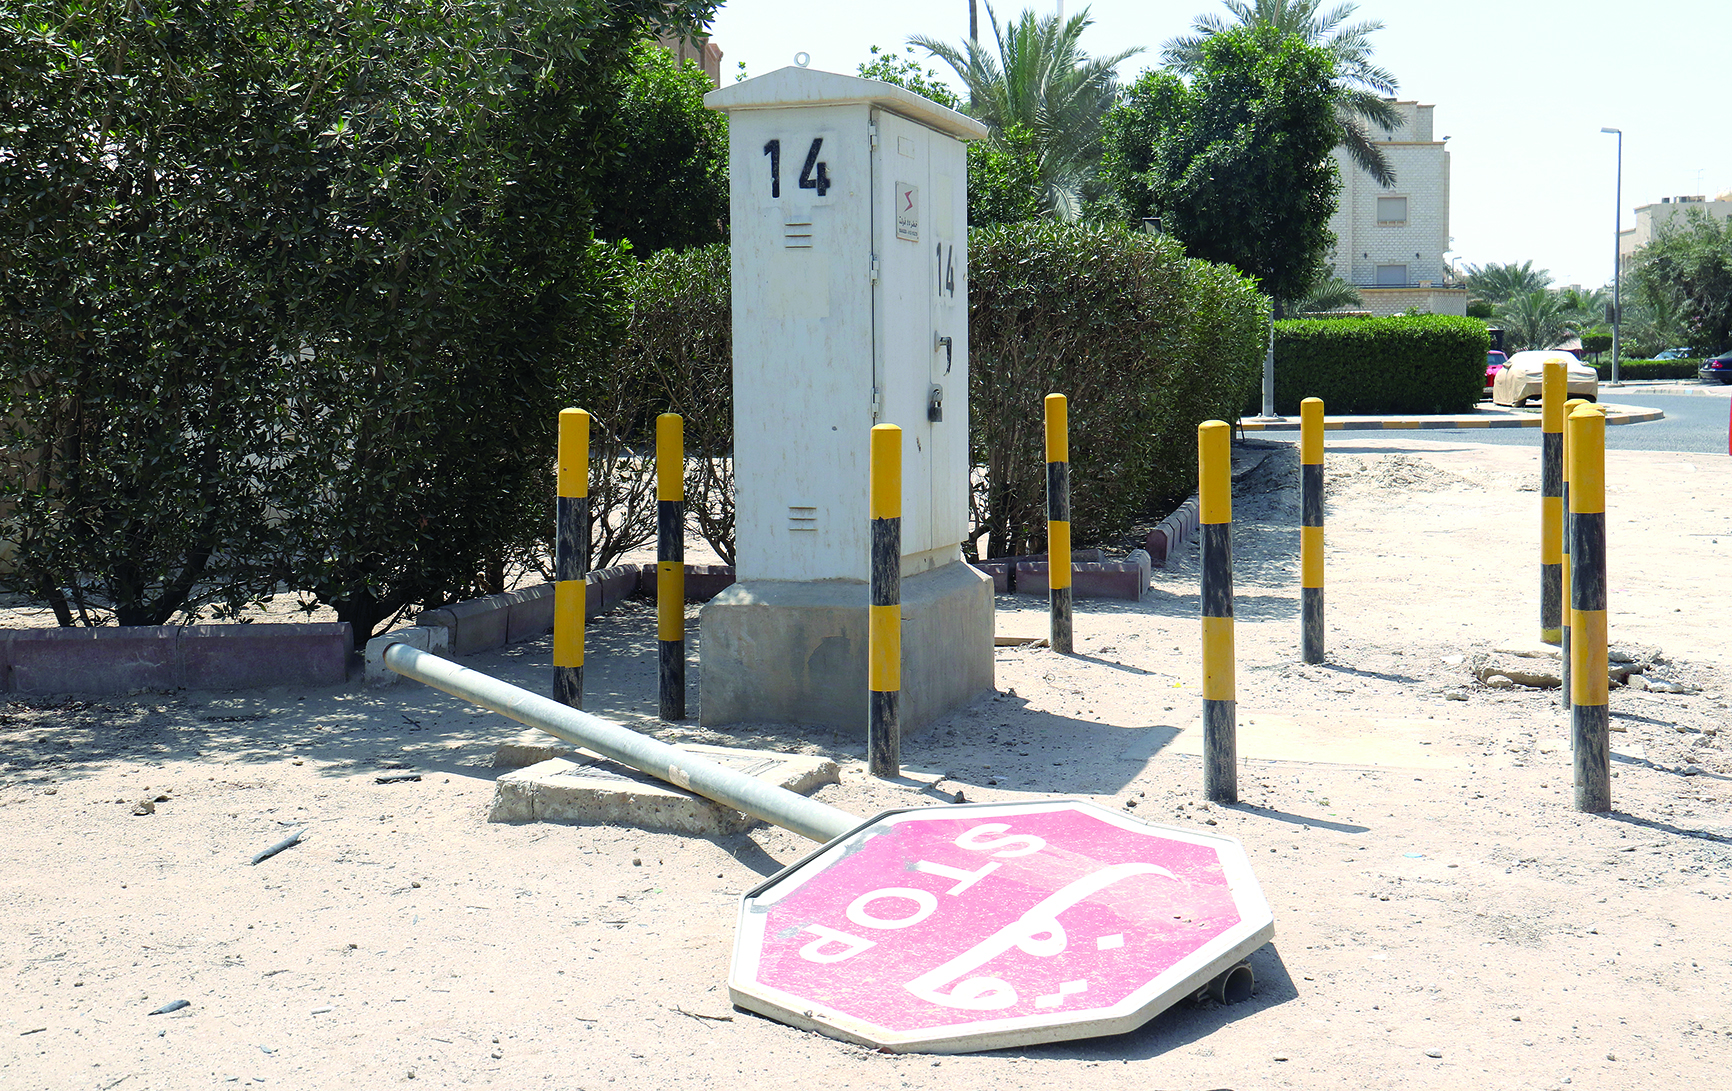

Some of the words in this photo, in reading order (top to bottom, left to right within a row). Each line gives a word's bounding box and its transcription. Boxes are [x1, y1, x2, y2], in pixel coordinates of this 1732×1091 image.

[763, 137, 831, 198] 14
[936, 242, 954, 298] 14
[800, 822, 1047, 963] STOP
[903, 862, 1178, 1010] قف
